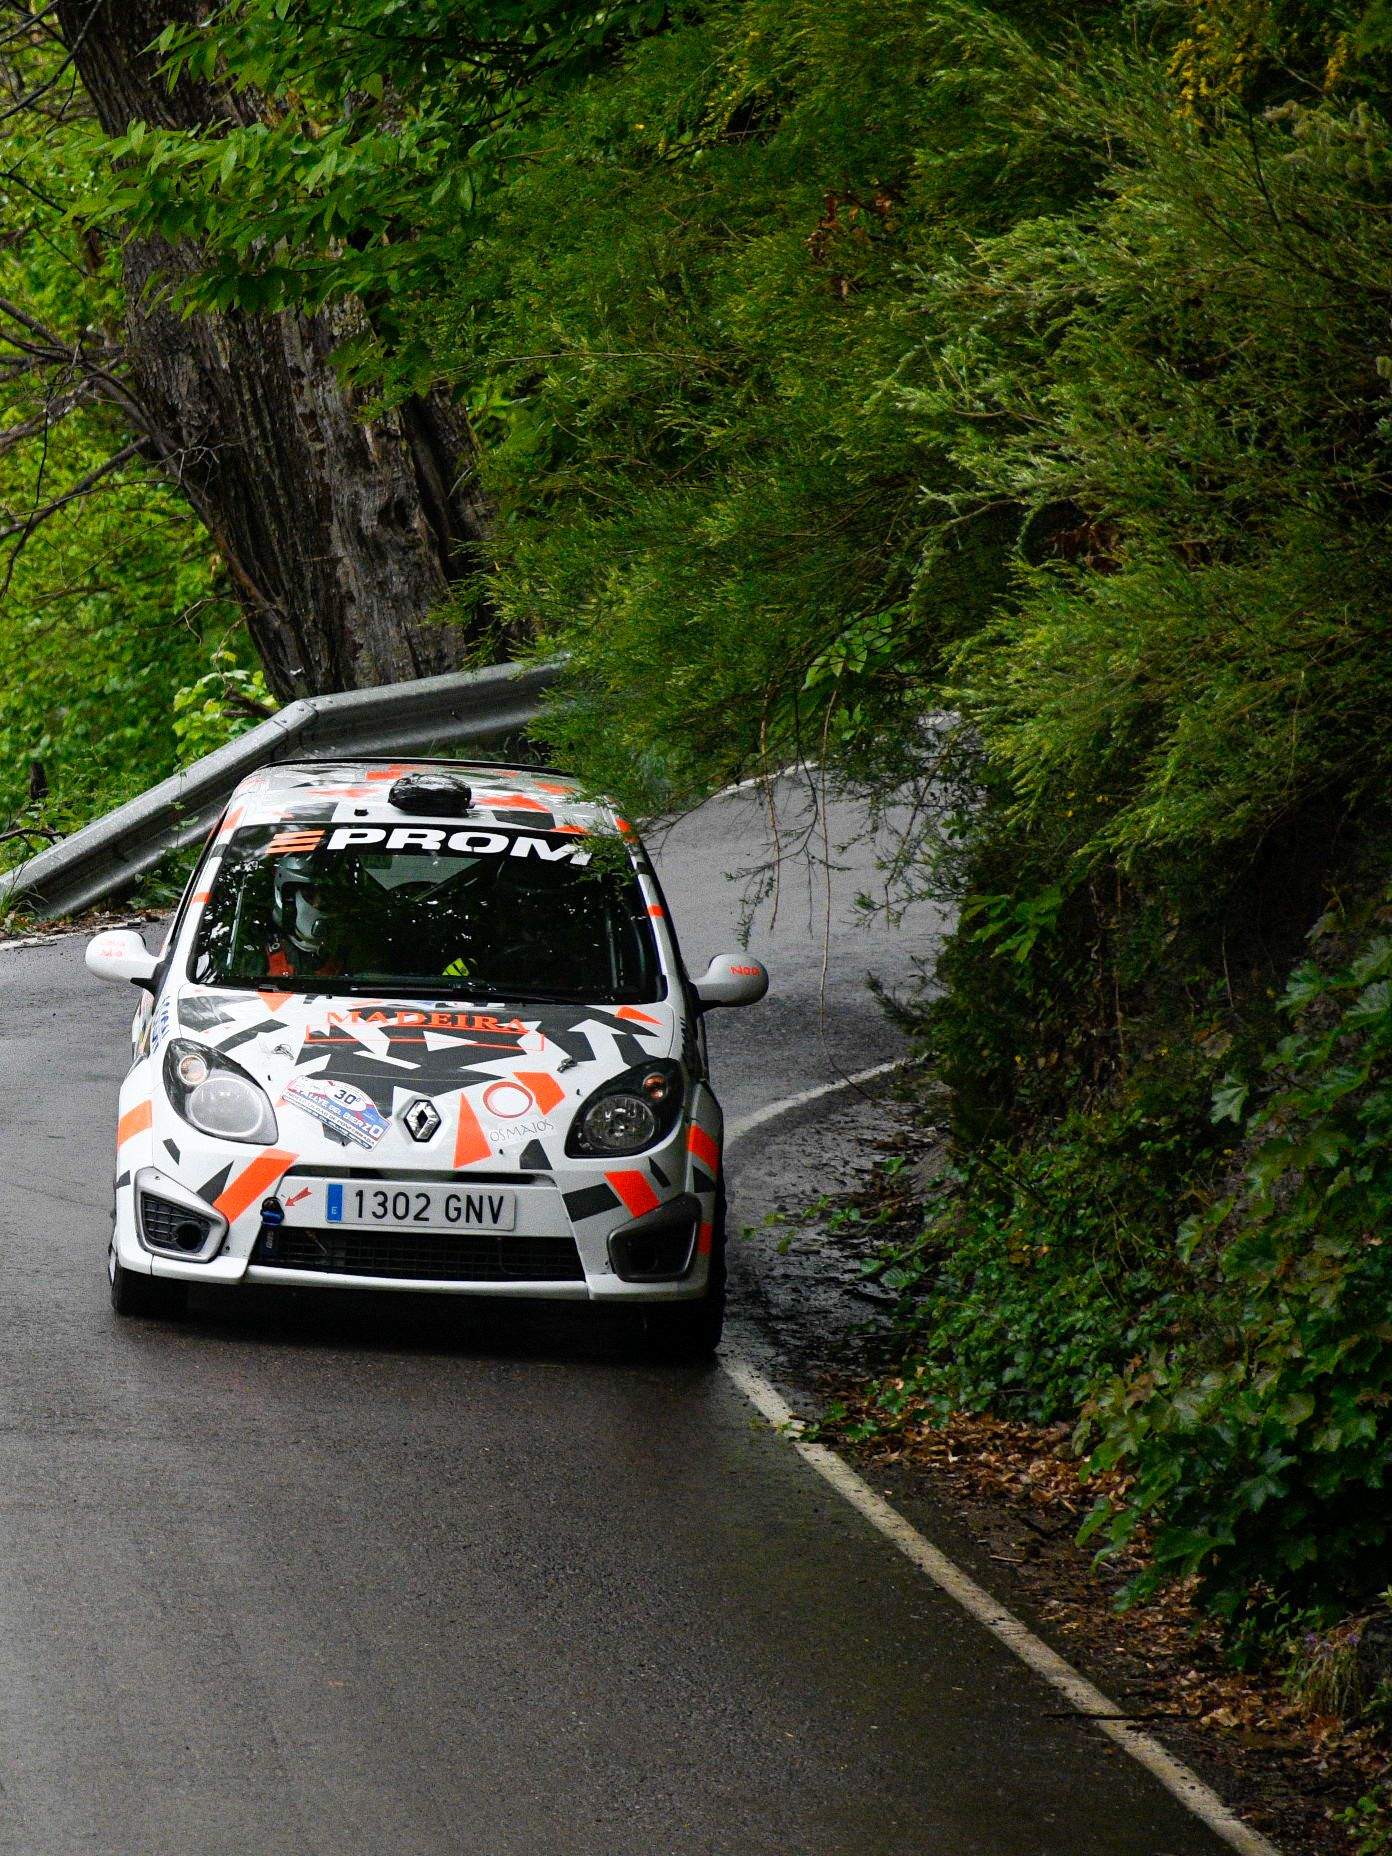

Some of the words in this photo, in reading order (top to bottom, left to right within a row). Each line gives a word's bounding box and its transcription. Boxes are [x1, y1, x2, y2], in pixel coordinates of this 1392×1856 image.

[326, 1010, 529, 1032] MADEIRA
[342, 1112, 384, 1138] BIERZO
[331, 1206, 337, 1215] E
[355, 1189, 430, 1222] 1302
[444, 1194, 504, 1224] GNV
